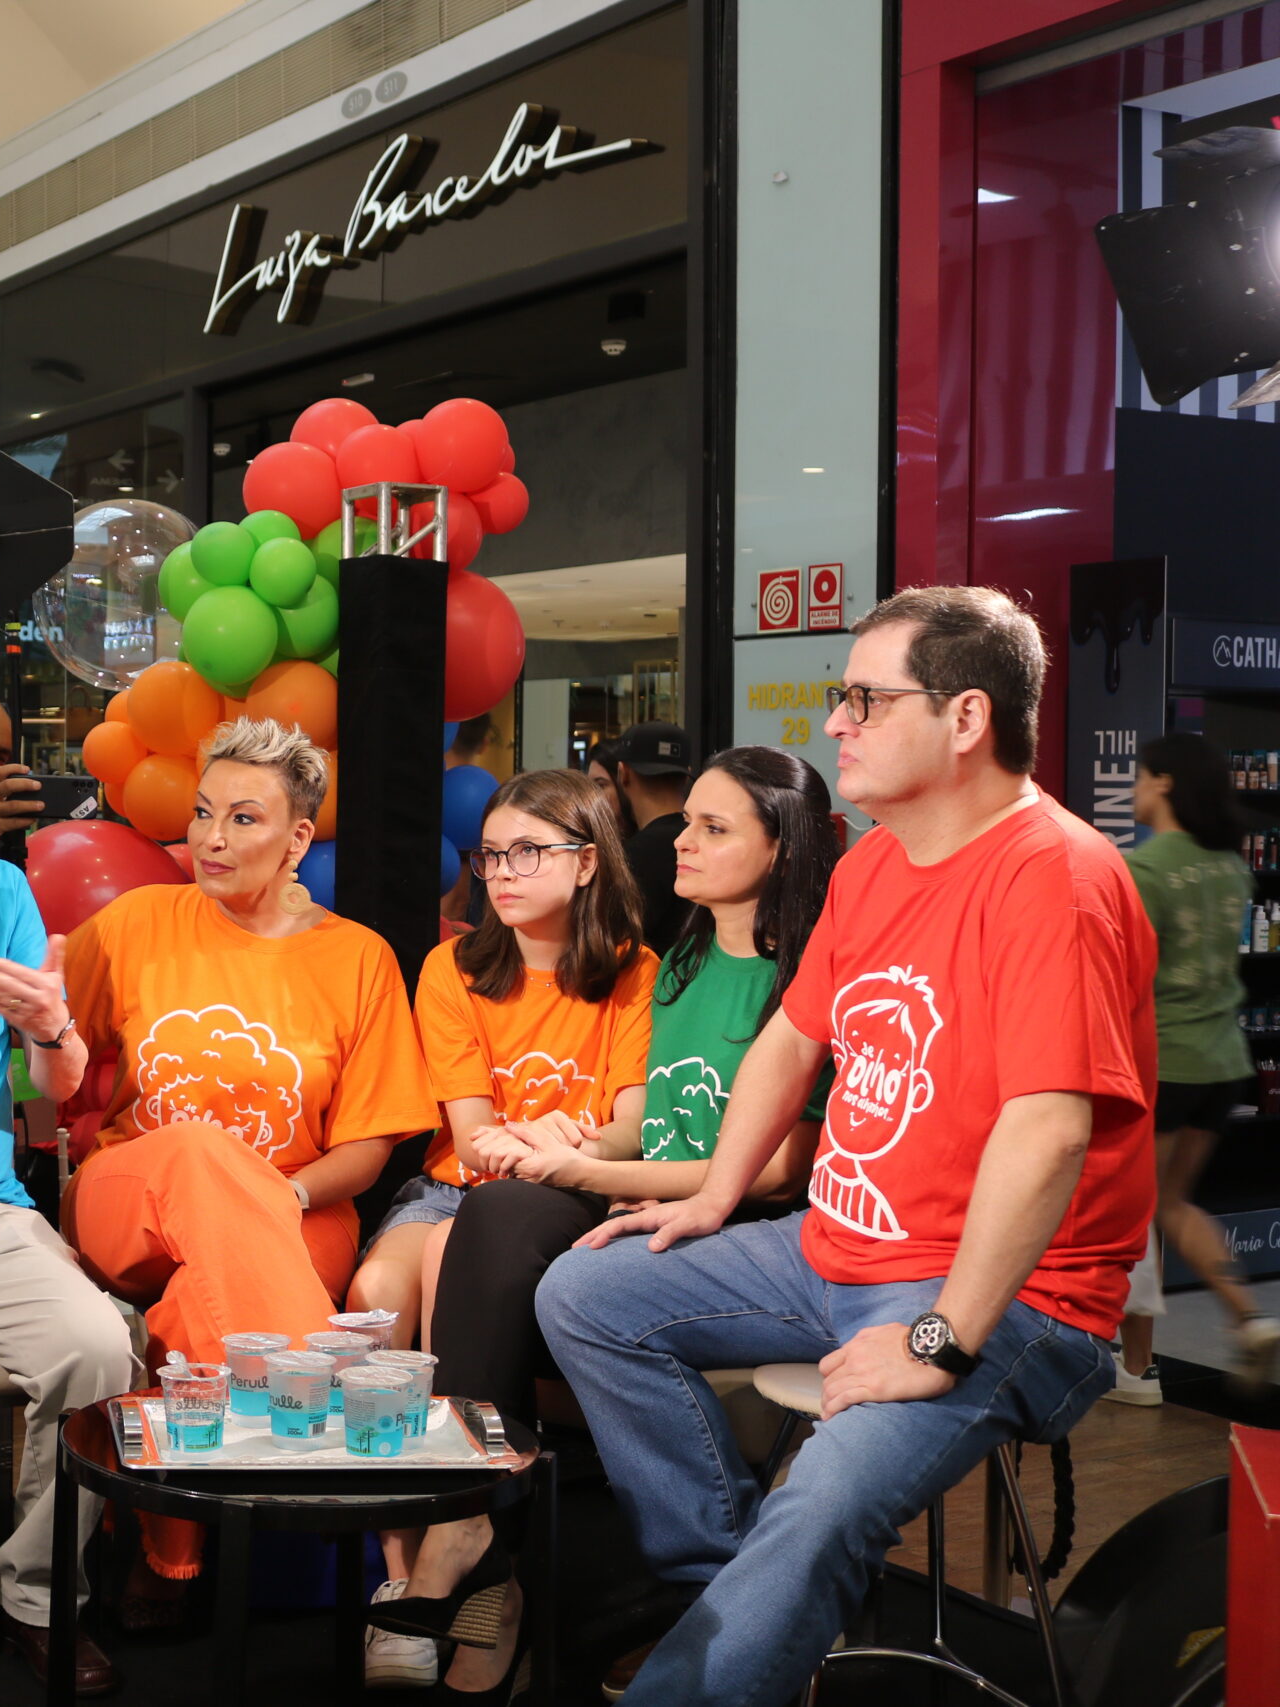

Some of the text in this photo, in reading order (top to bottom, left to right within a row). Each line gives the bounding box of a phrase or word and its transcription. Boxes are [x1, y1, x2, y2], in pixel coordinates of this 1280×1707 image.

[1233, 635, 1280, 669] CATH
[781, 717, 811, 745] 29
[861, 1041, 874, 1058] de
[184, 1102, 197, 1113] de
[1224, 1226, 1264, 1262] Maria
